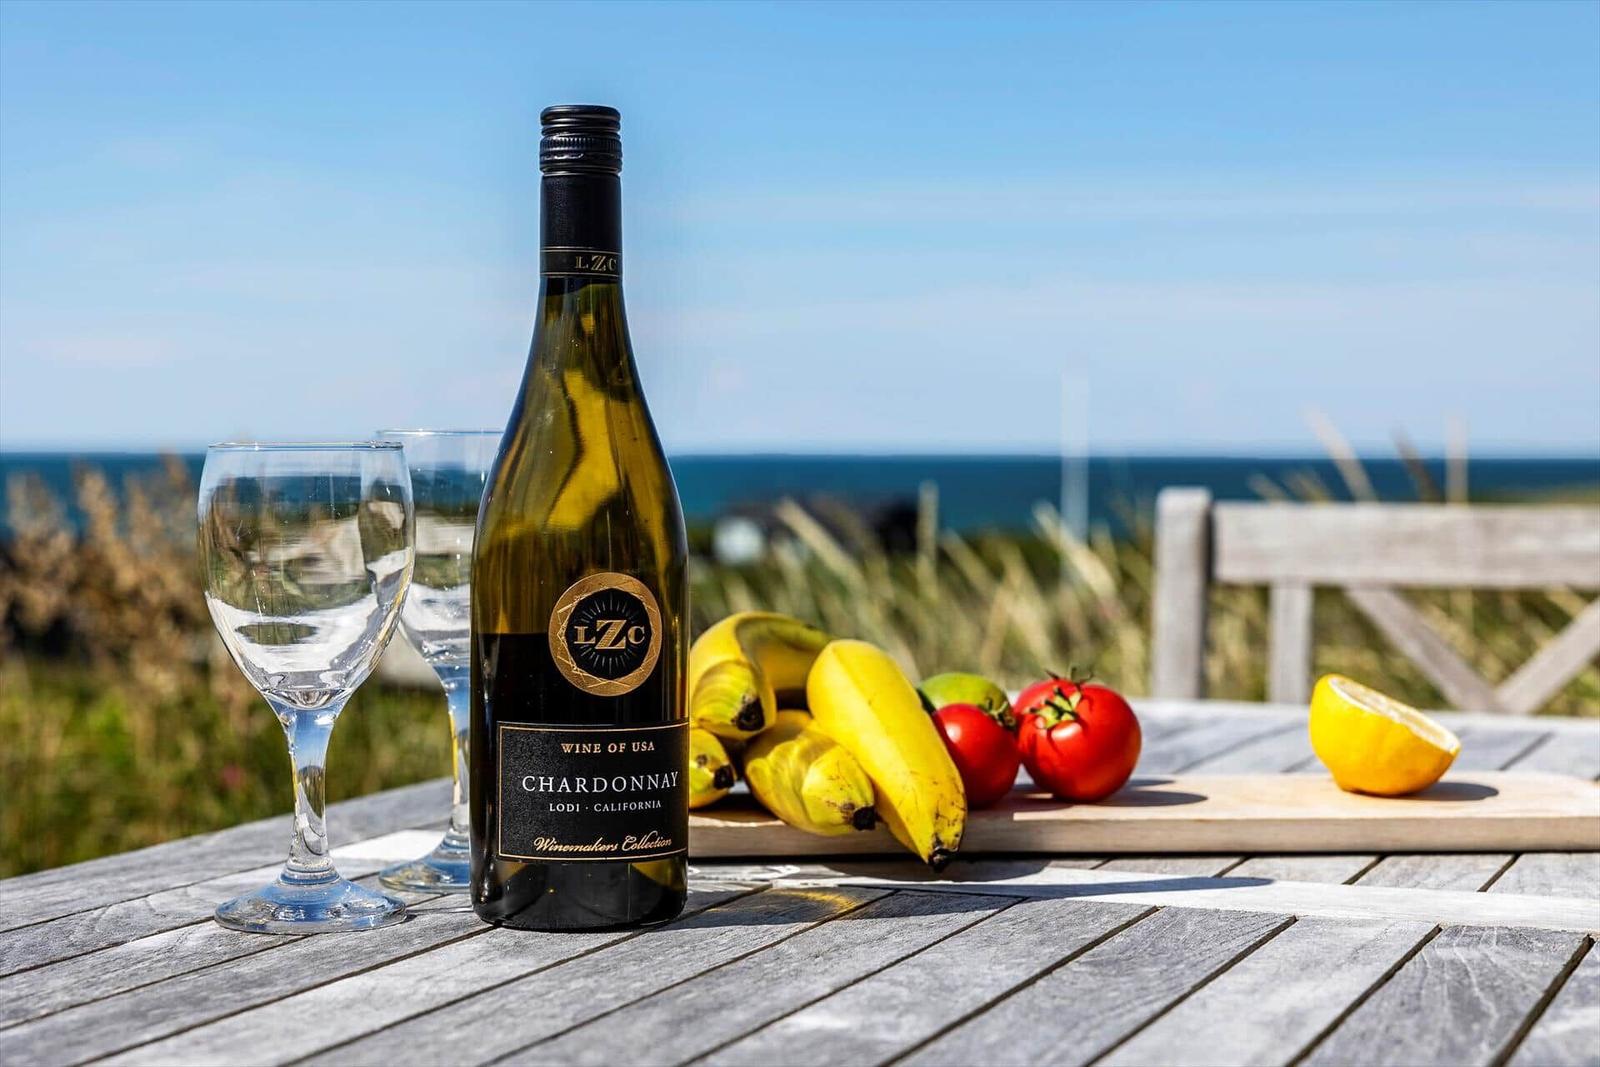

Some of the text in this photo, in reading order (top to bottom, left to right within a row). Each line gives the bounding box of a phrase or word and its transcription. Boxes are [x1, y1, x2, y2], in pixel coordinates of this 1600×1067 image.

[574, 255, 617, 272] LZC
[573, 619, 645, 650] LZC
[560, 741, 655, 754] WINE OF USA
[522, 771, 679, 793] CHARDONNAY
[549, 800, 662, 813] LODI CALIFORNIA
[533, 830, 672, 853] Winemakers Collection
